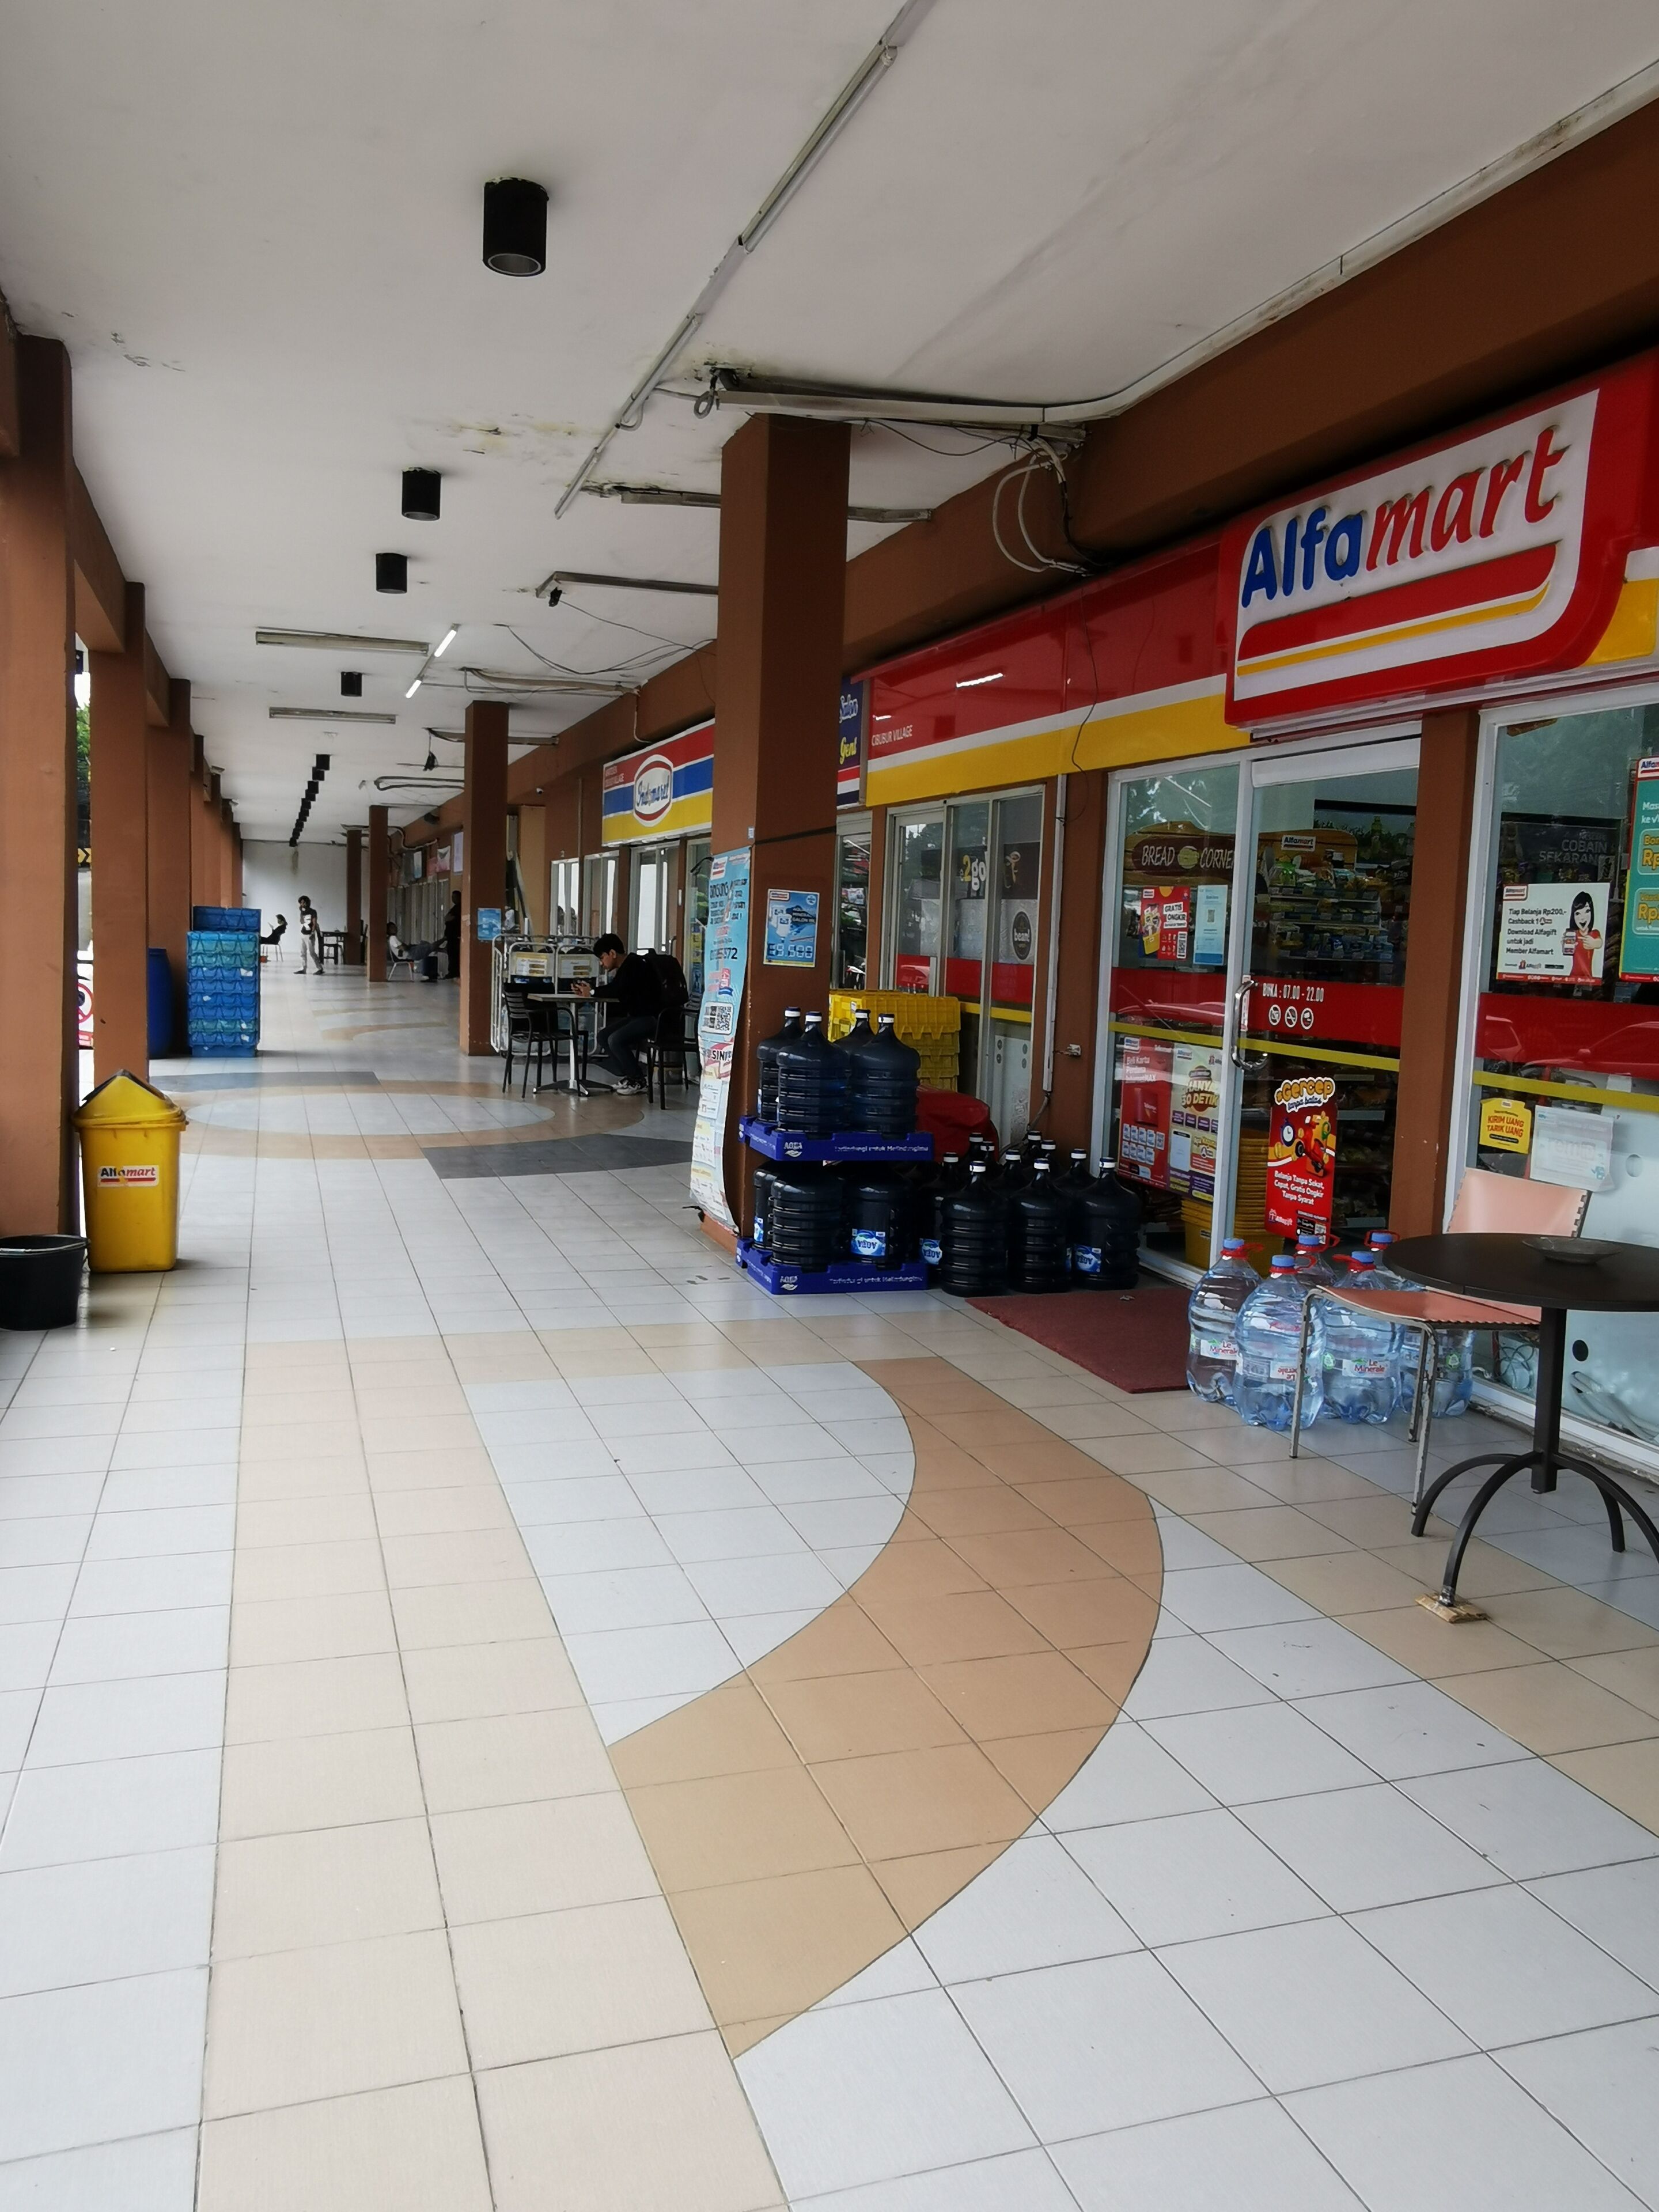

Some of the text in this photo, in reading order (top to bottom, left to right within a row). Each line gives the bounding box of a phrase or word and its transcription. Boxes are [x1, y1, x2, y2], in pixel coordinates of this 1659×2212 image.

[1241, 425, 1573, 608] Alfamart
[872, 725, 913, 746] CIBUBUR VILLAGE
[1284, 836, 1315, 846] Alfamart
[1562, 839, 1608, 853] COBAIN
[1142, 845, 1234, 869] BREAD CORNE
[1539, 851, 1599, 865] SEKARAN
[1165, 904, 1182, 912] GRATIS
[1521, 908, 1541, 916] Belanja
[1535, 929, 1557, 937] Alfagift
[1263, 983, 1278, 998] BUKA
[1283, 984, 1300, 999] 07.00
[1306, 986, 1324, 1002] 22.00
[1181, 1092, 1219, 1106] 30 DETIK
[1487, 1115, 1525, 1128] KIRIM UANG
[1487, 1124, 1524, 1138] TARIK UANG
[100, 1167, 156, 1177] Alfamart
[1274, 1171, 1292, 1181] Belanja
[1293, 1175, 1308, 1184] Tanpa
[1282, 1190, 1315, 1205] Tanpa Syarat
[1290, 1184, 1305, 1194] Gratis
[1306, 1187, 1324, 1198] Ongkir
[858, 1239, 877, 1249] AQUA
[1222, 1341, 1232, 1349] Le
[1354, 1364, 1386, 1373] Minerale
